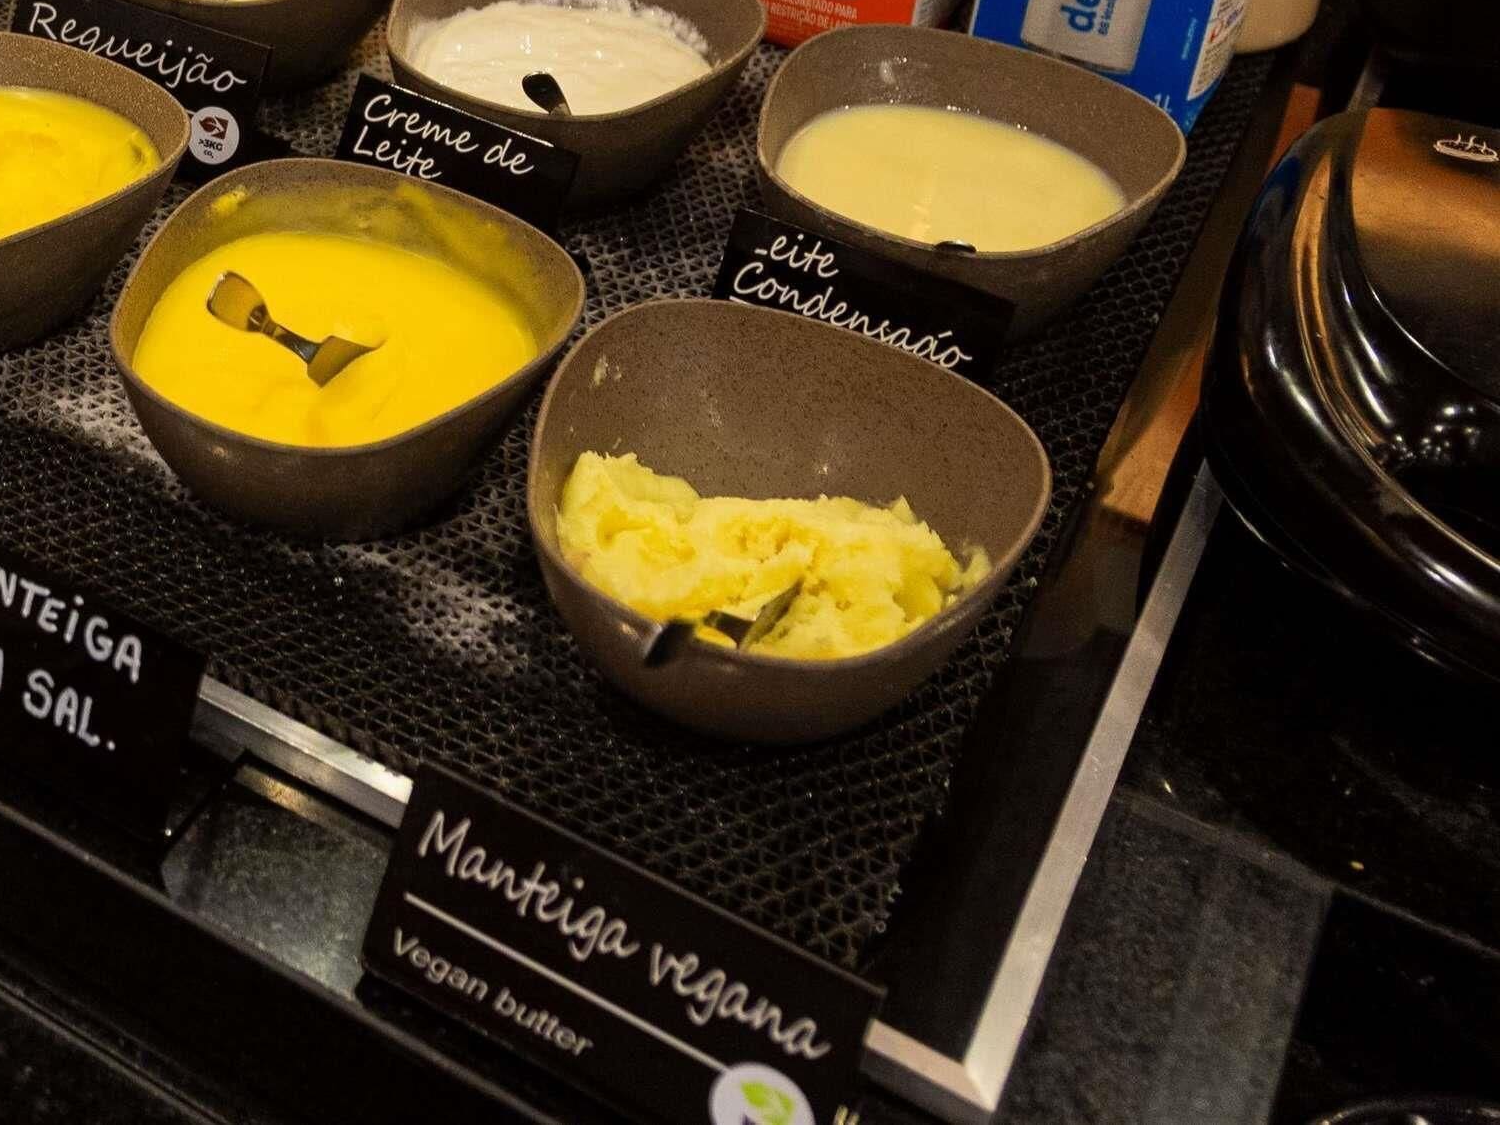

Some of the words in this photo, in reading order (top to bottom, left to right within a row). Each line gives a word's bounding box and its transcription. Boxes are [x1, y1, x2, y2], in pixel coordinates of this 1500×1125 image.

[28, 1, 249, 93] Requeijão
[352, 124, 443, 180] Leite
[362, 93, 480, 154] Creme
[483, 137, 535, 176] de
[754, 233, 840, 279] eite
[417, 810, 641, 962] Manteiga
[648, 942, 832, 1060] vegana
[392, 928, 489, 1002] Vegan
[492, 986, 594, 1058] butter
